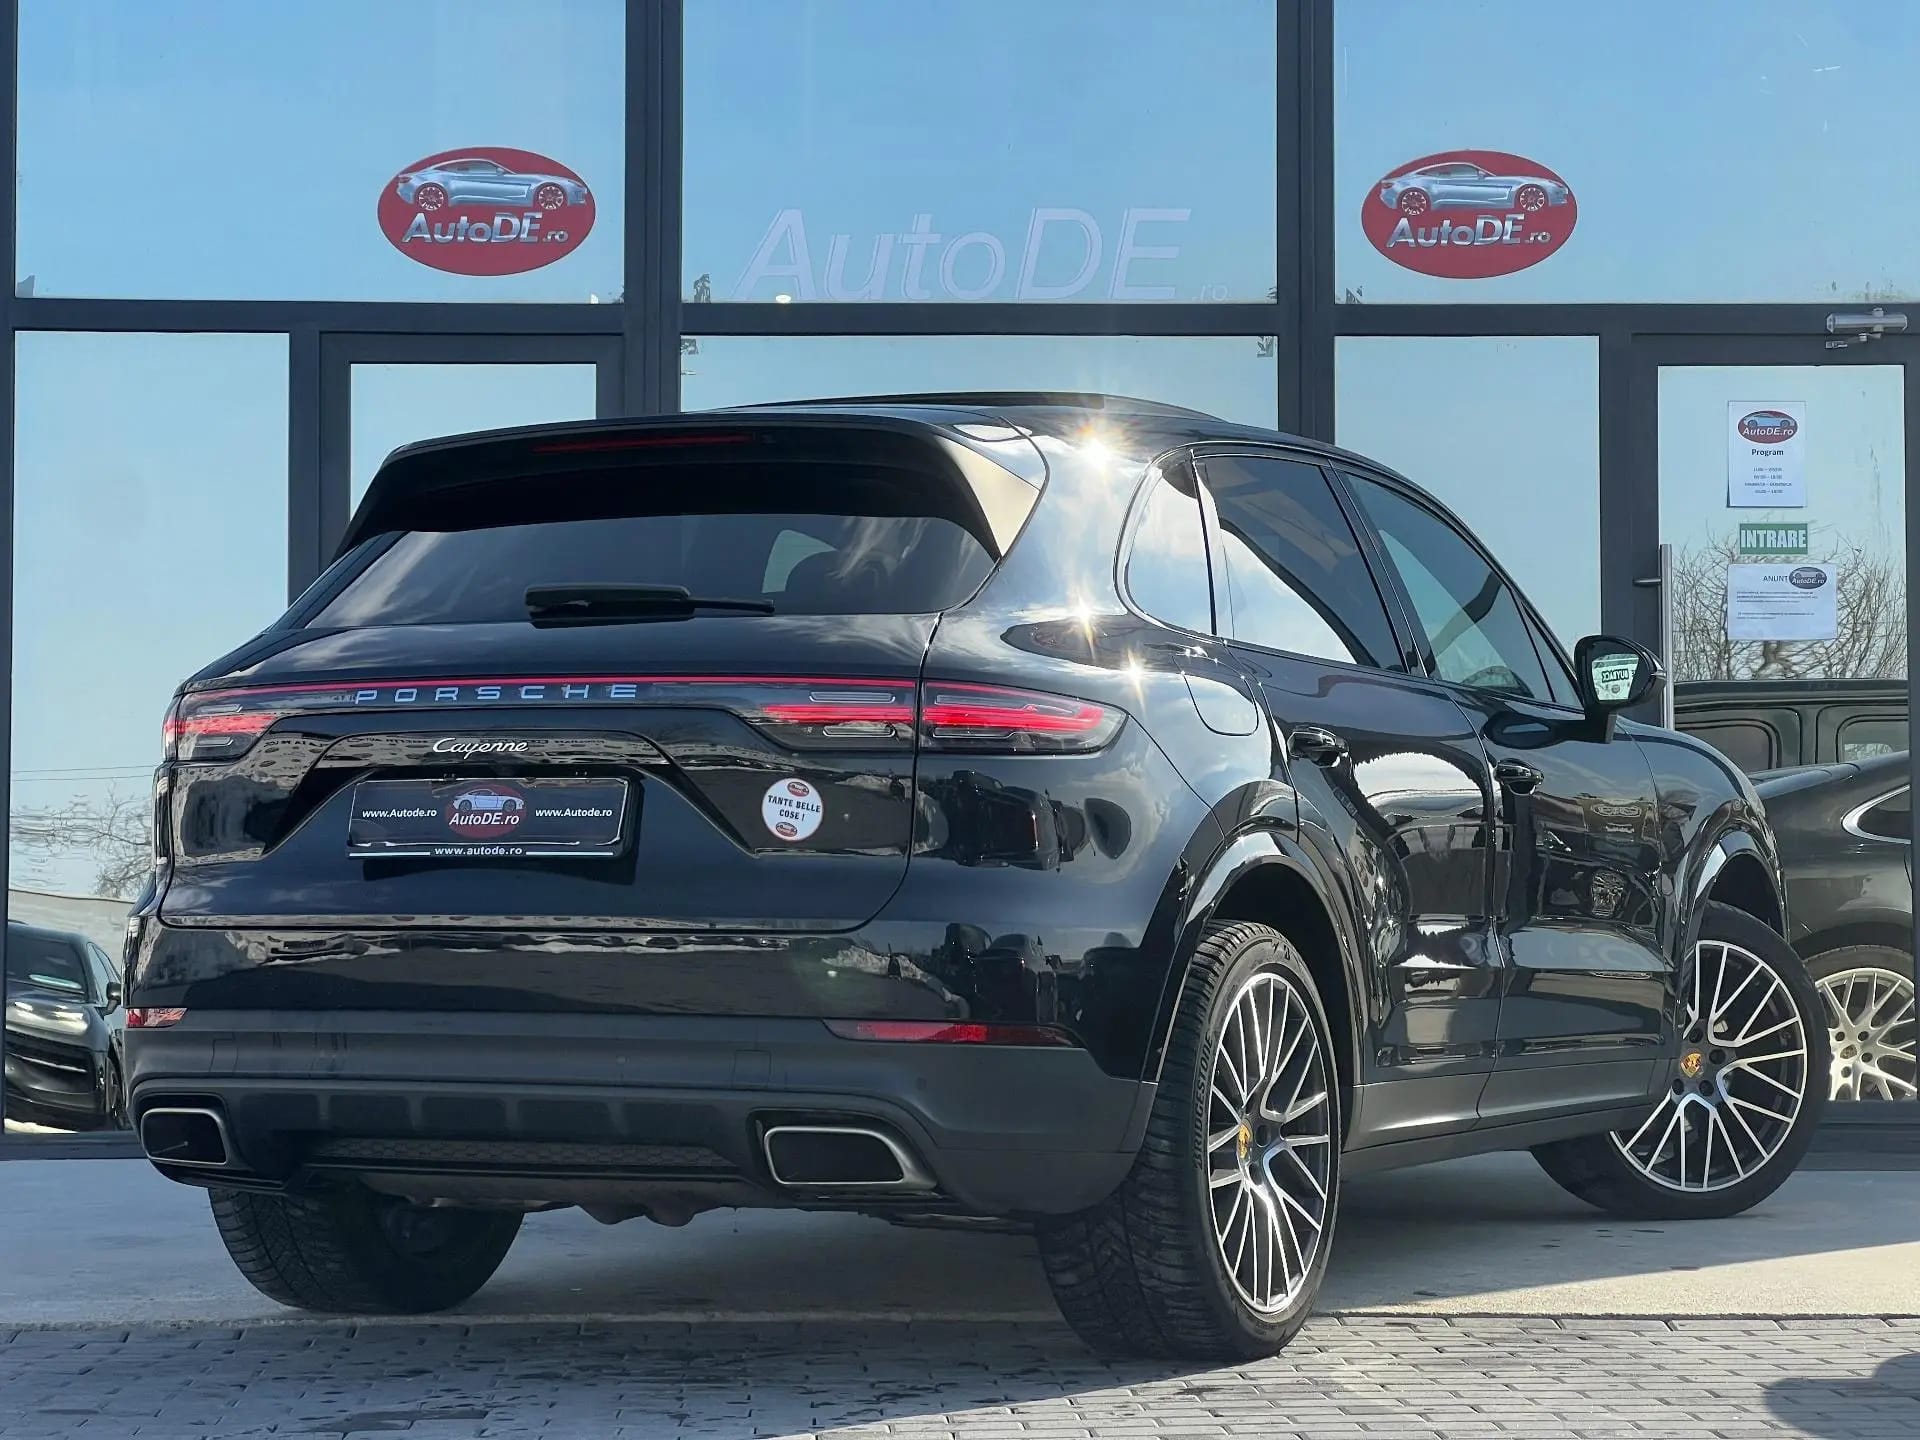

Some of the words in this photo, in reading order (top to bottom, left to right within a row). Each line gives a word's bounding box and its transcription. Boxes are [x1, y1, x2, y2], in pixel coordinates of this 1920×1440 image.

[730, 207, 1192, 302] AutoDE
[1742, 426, 1794, 436] AutoDE.ro
[1751, 448, 1784, 456] Program
[1741, 529, 1807, 548] INTRARE
[354, 683, 639, 705] PORSCHE
[432, 736, 529, 760] Cayenne
[768, 795, 793, 807] TANTE
[796, 802, 821, 812] BELLE
[361, 808, 438, 819] www.Autode.ro
[448, 812, 521, 827] AutoDE.ro
[534, 808, 614, 818] www.Autode.ro
[779, 809, 799, 820] COSE
[433, 846, 524, 856] www.autode.ro
[1192, 1031, 1214, 1170] BRIDGESTONE
